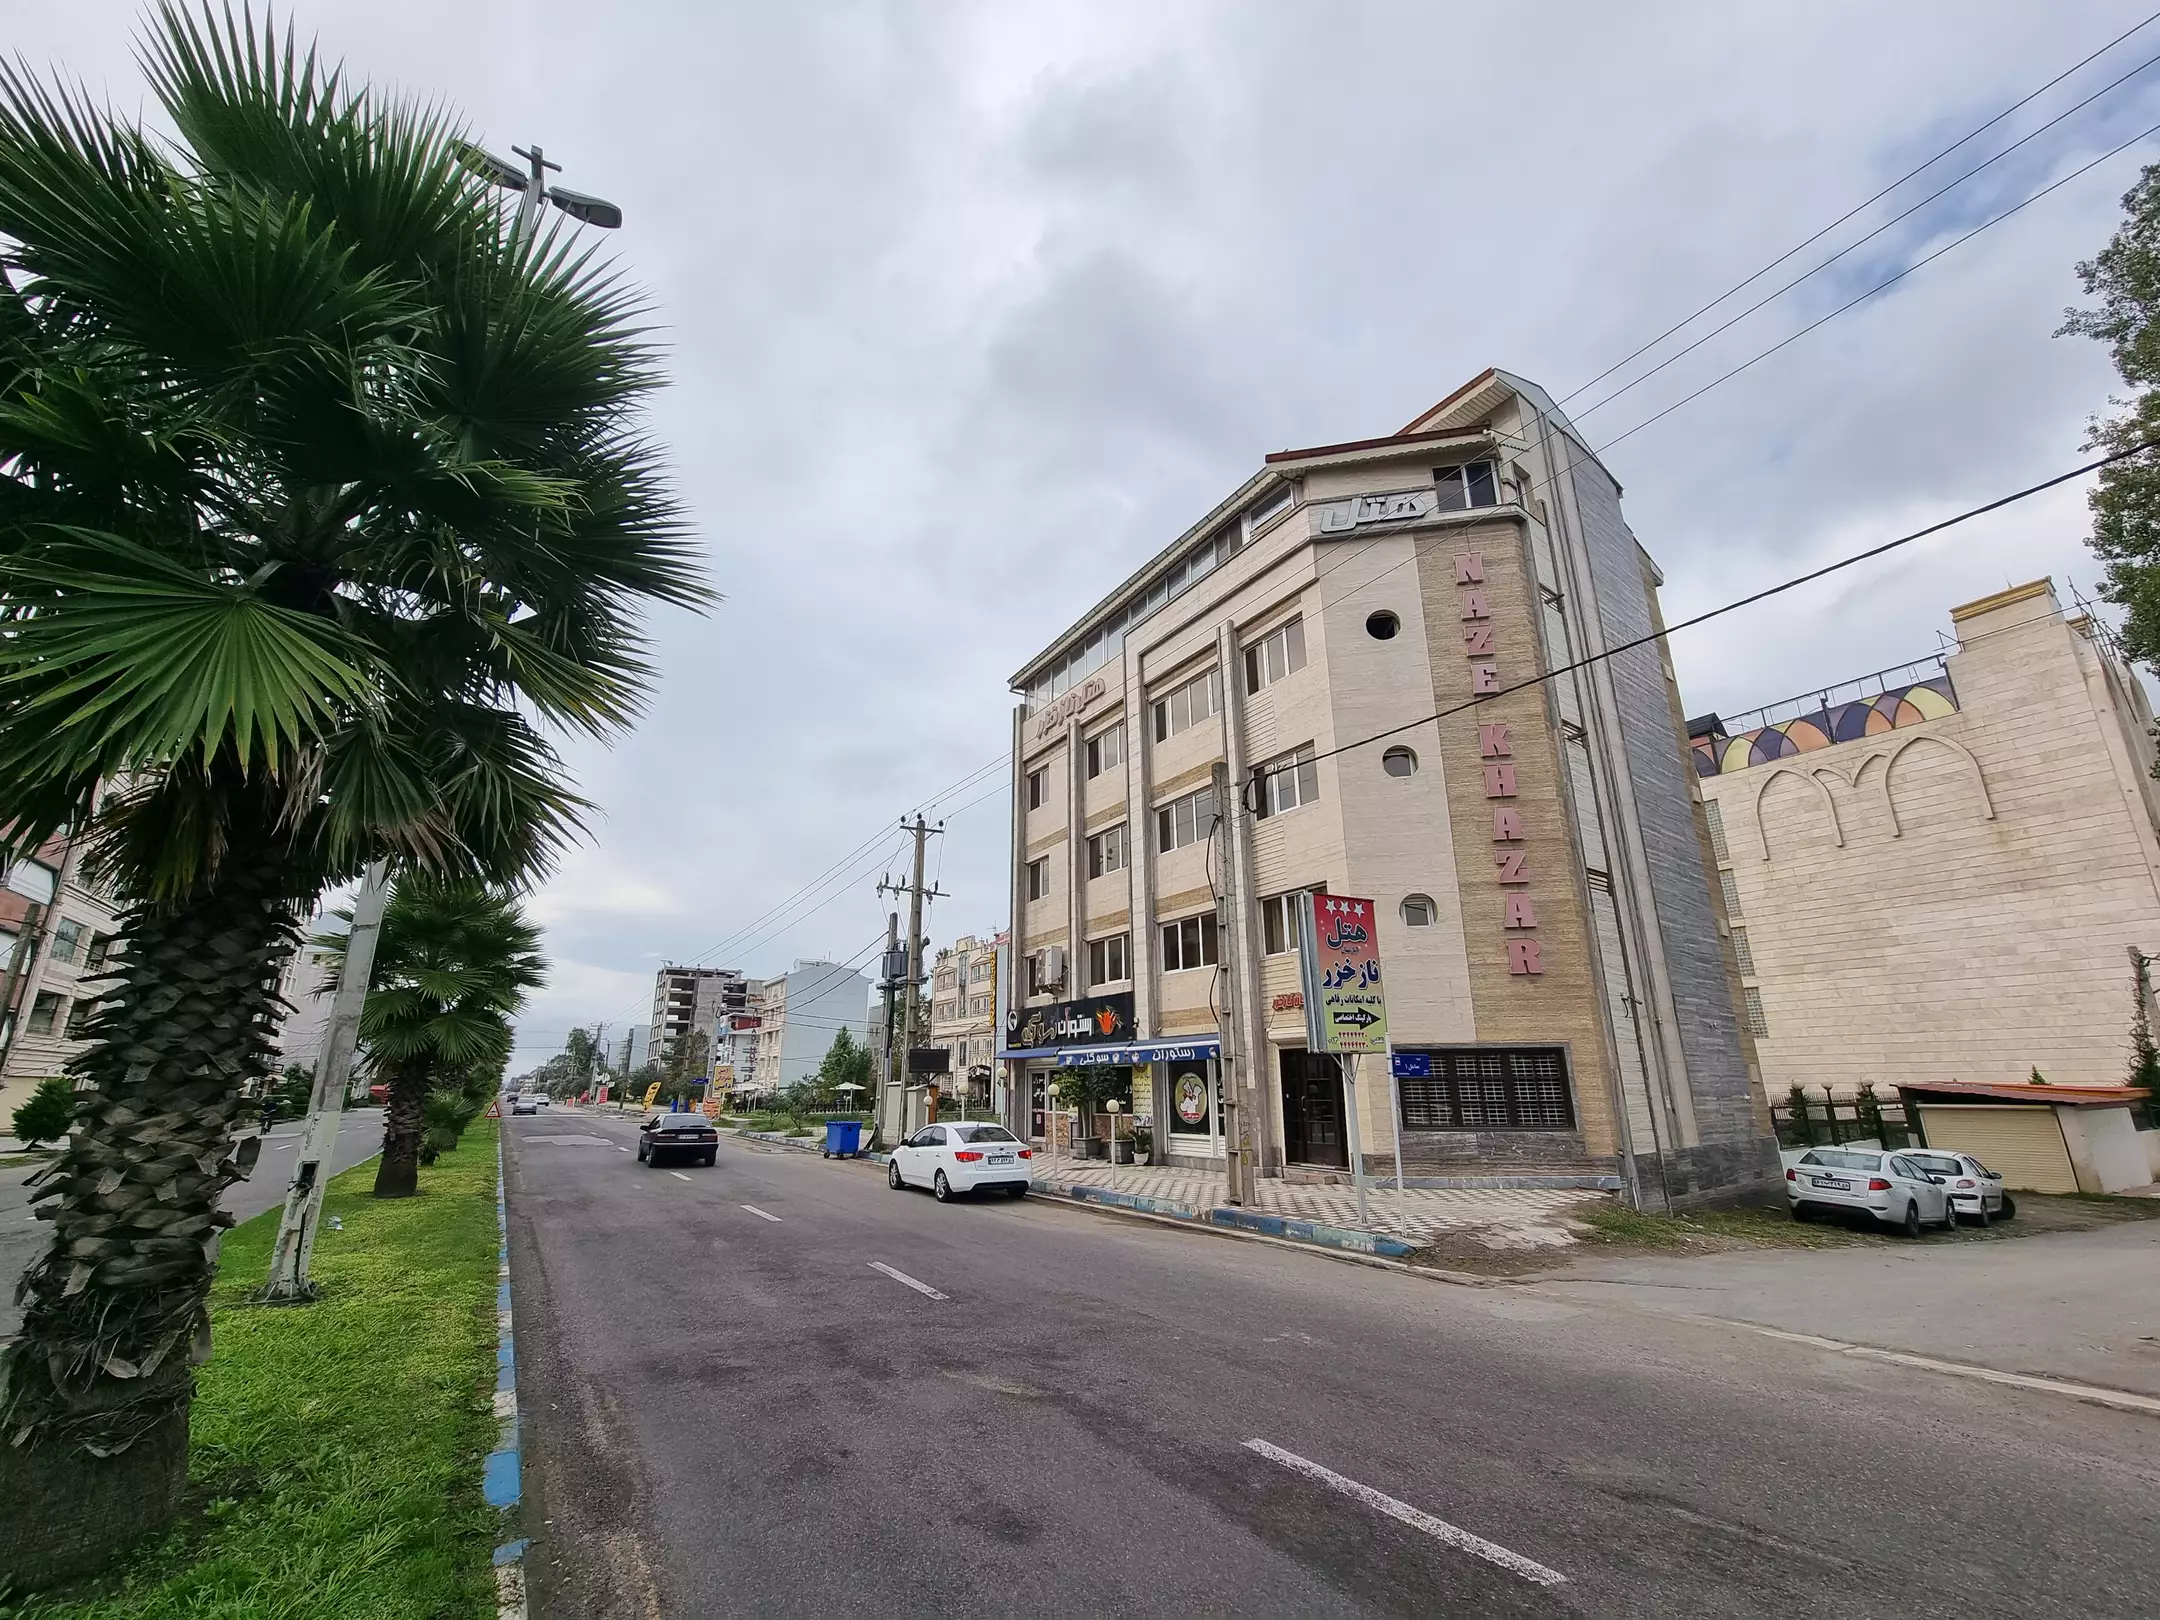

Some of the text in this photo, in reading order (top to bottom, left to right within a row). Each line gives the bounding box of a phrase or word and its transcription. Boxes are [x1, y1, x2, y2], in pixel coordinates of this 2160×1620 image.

[1321, 497, 1427, 533] هتل
[1455, 552, 1544, 976] NAZE KHAZAR
[1326, 916, 1368, 950] هتل
[1321, 957, 1380, 990] ناز خزر
[1344, 994, 1365, 1005] امکانات
[1058, 1006, 1094, 1039] رستوران
[1152, 1047, 1196, 1061] رستوران
